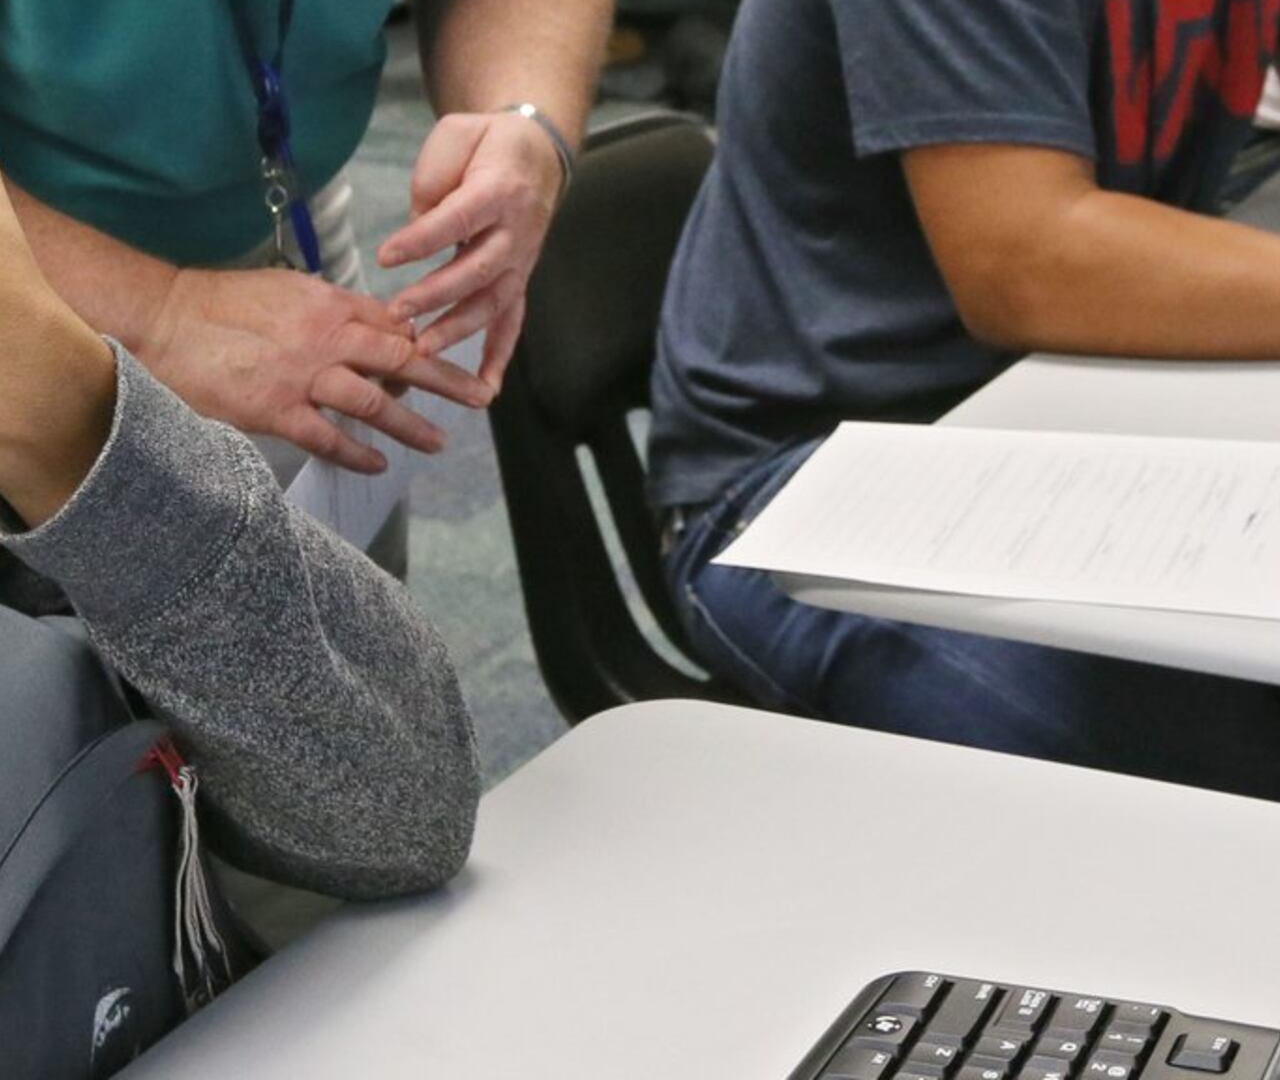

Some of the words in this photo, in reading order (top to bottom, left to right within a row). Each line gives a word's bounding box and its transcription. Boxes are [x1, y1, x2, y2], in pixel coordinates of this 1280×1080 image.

[1000, 1040, 1016, 1050] A
[1060, 1042, 1077, 1052] Q
[935, 1047, 952, 1057] Z
[982, 1070, 998, 1079] S
